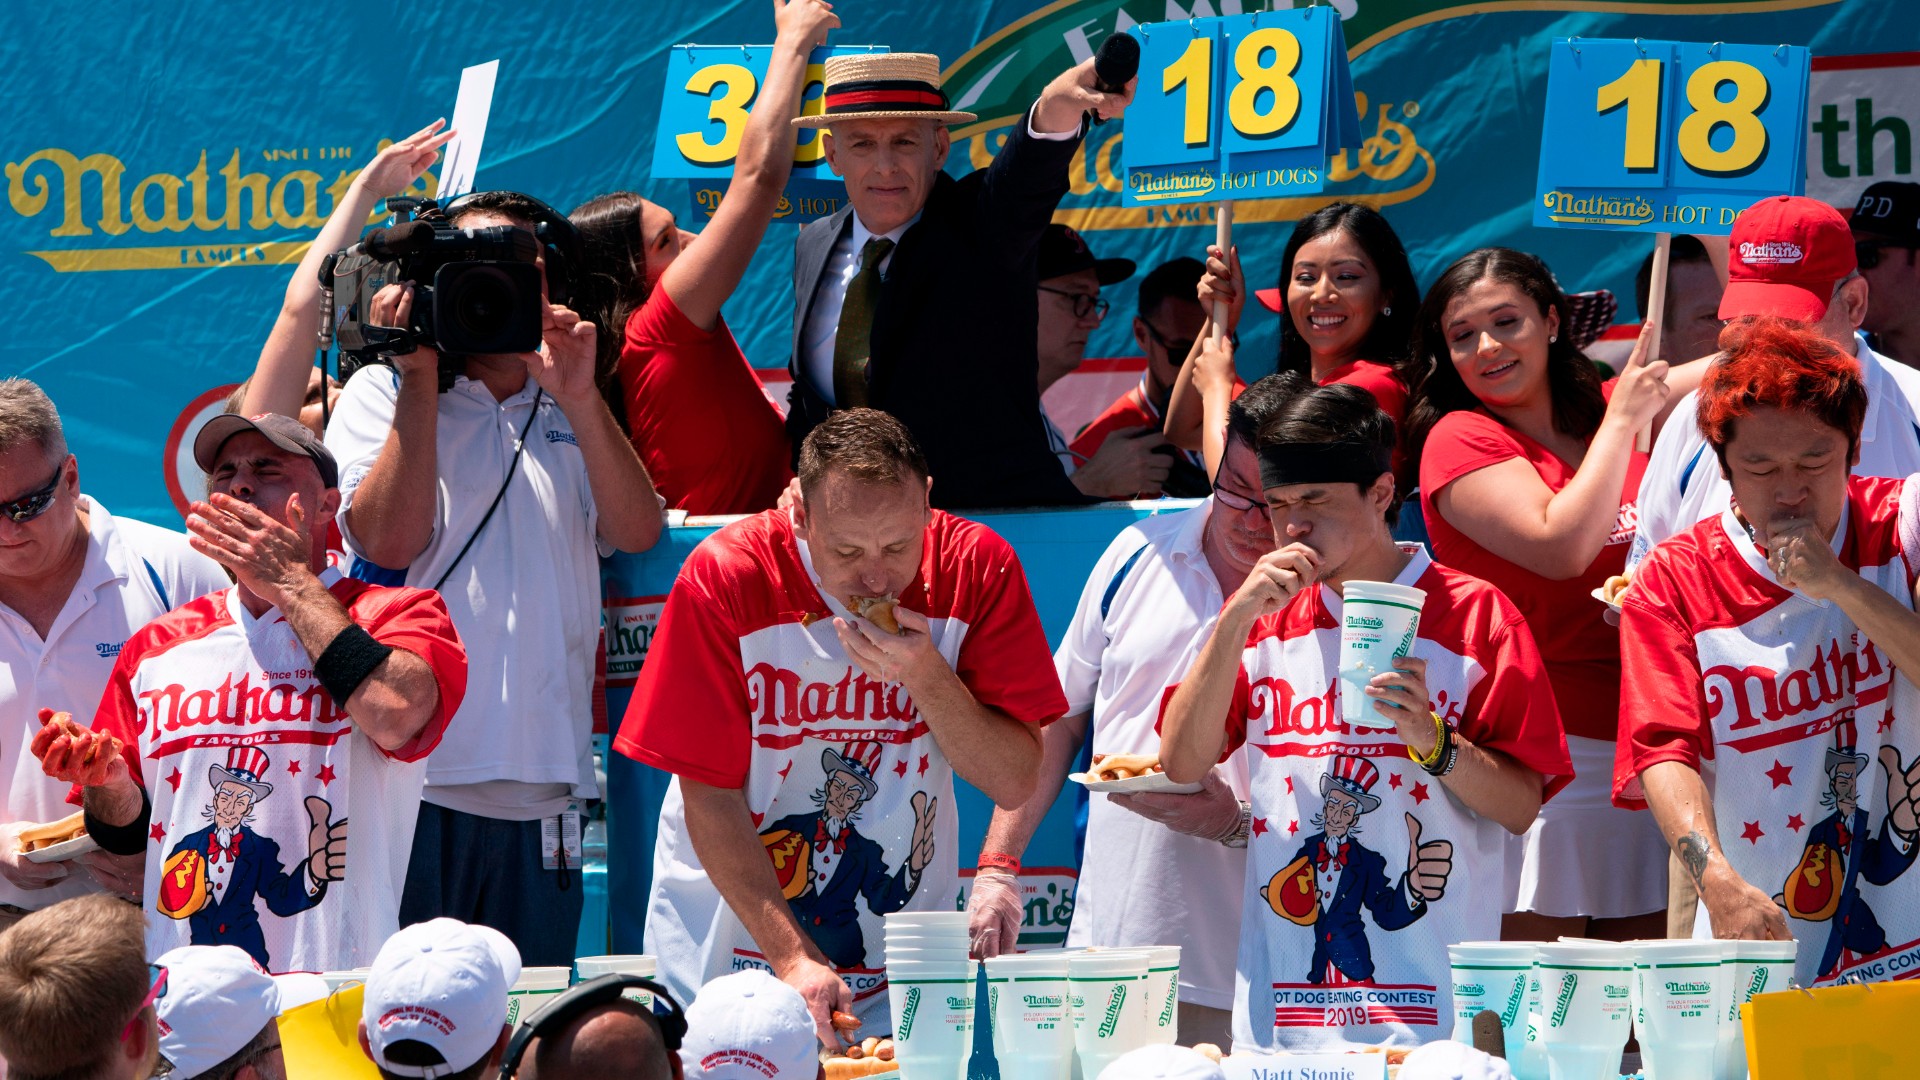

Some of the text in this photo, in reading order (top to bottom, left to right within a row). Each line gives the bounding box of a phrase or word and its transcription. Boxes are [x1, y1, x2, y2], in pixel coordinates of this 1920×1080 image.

[1162, 28, 1301, 144] 18
[1597, 59, 1768, 172] 18
[1811, 98, 1912, 178] th
[1129, 166, 1319, 193] Nathan's HOT DOGS
[800, 198, 840, 215] HOT
[1543, 190, 1655, 218] Nathan's
[1662, 205, 1713, 225] HOT
[1740, 241, 1803, 258] Nathan's
[1346, 616, 1384, 628] Nathan's
[262, 670, 291, 681] Since
[194, 733, 281, 746] FAMOUS
[1307, 744, 1384, 756] FAMOUS
[1665, 981, 1711, 992] Nathan's
[1295, 991, 1325, 1004] DOG
[1329, 990, 1362, 1004] EATING
[1367, 991, 1436, 1005] CONTEST
[1501, 973, 1526, 1028] Nathan's
[1551, 973, 1577, 1028] Nathan's
[898, 986, 920, 1041] Nathan's
[1098, 984, 1126, 1038] Nathan's
[1326, 1007, 1367, 1027] 2019
[1252, 1067, 1355, 1080] Matt Stonie
